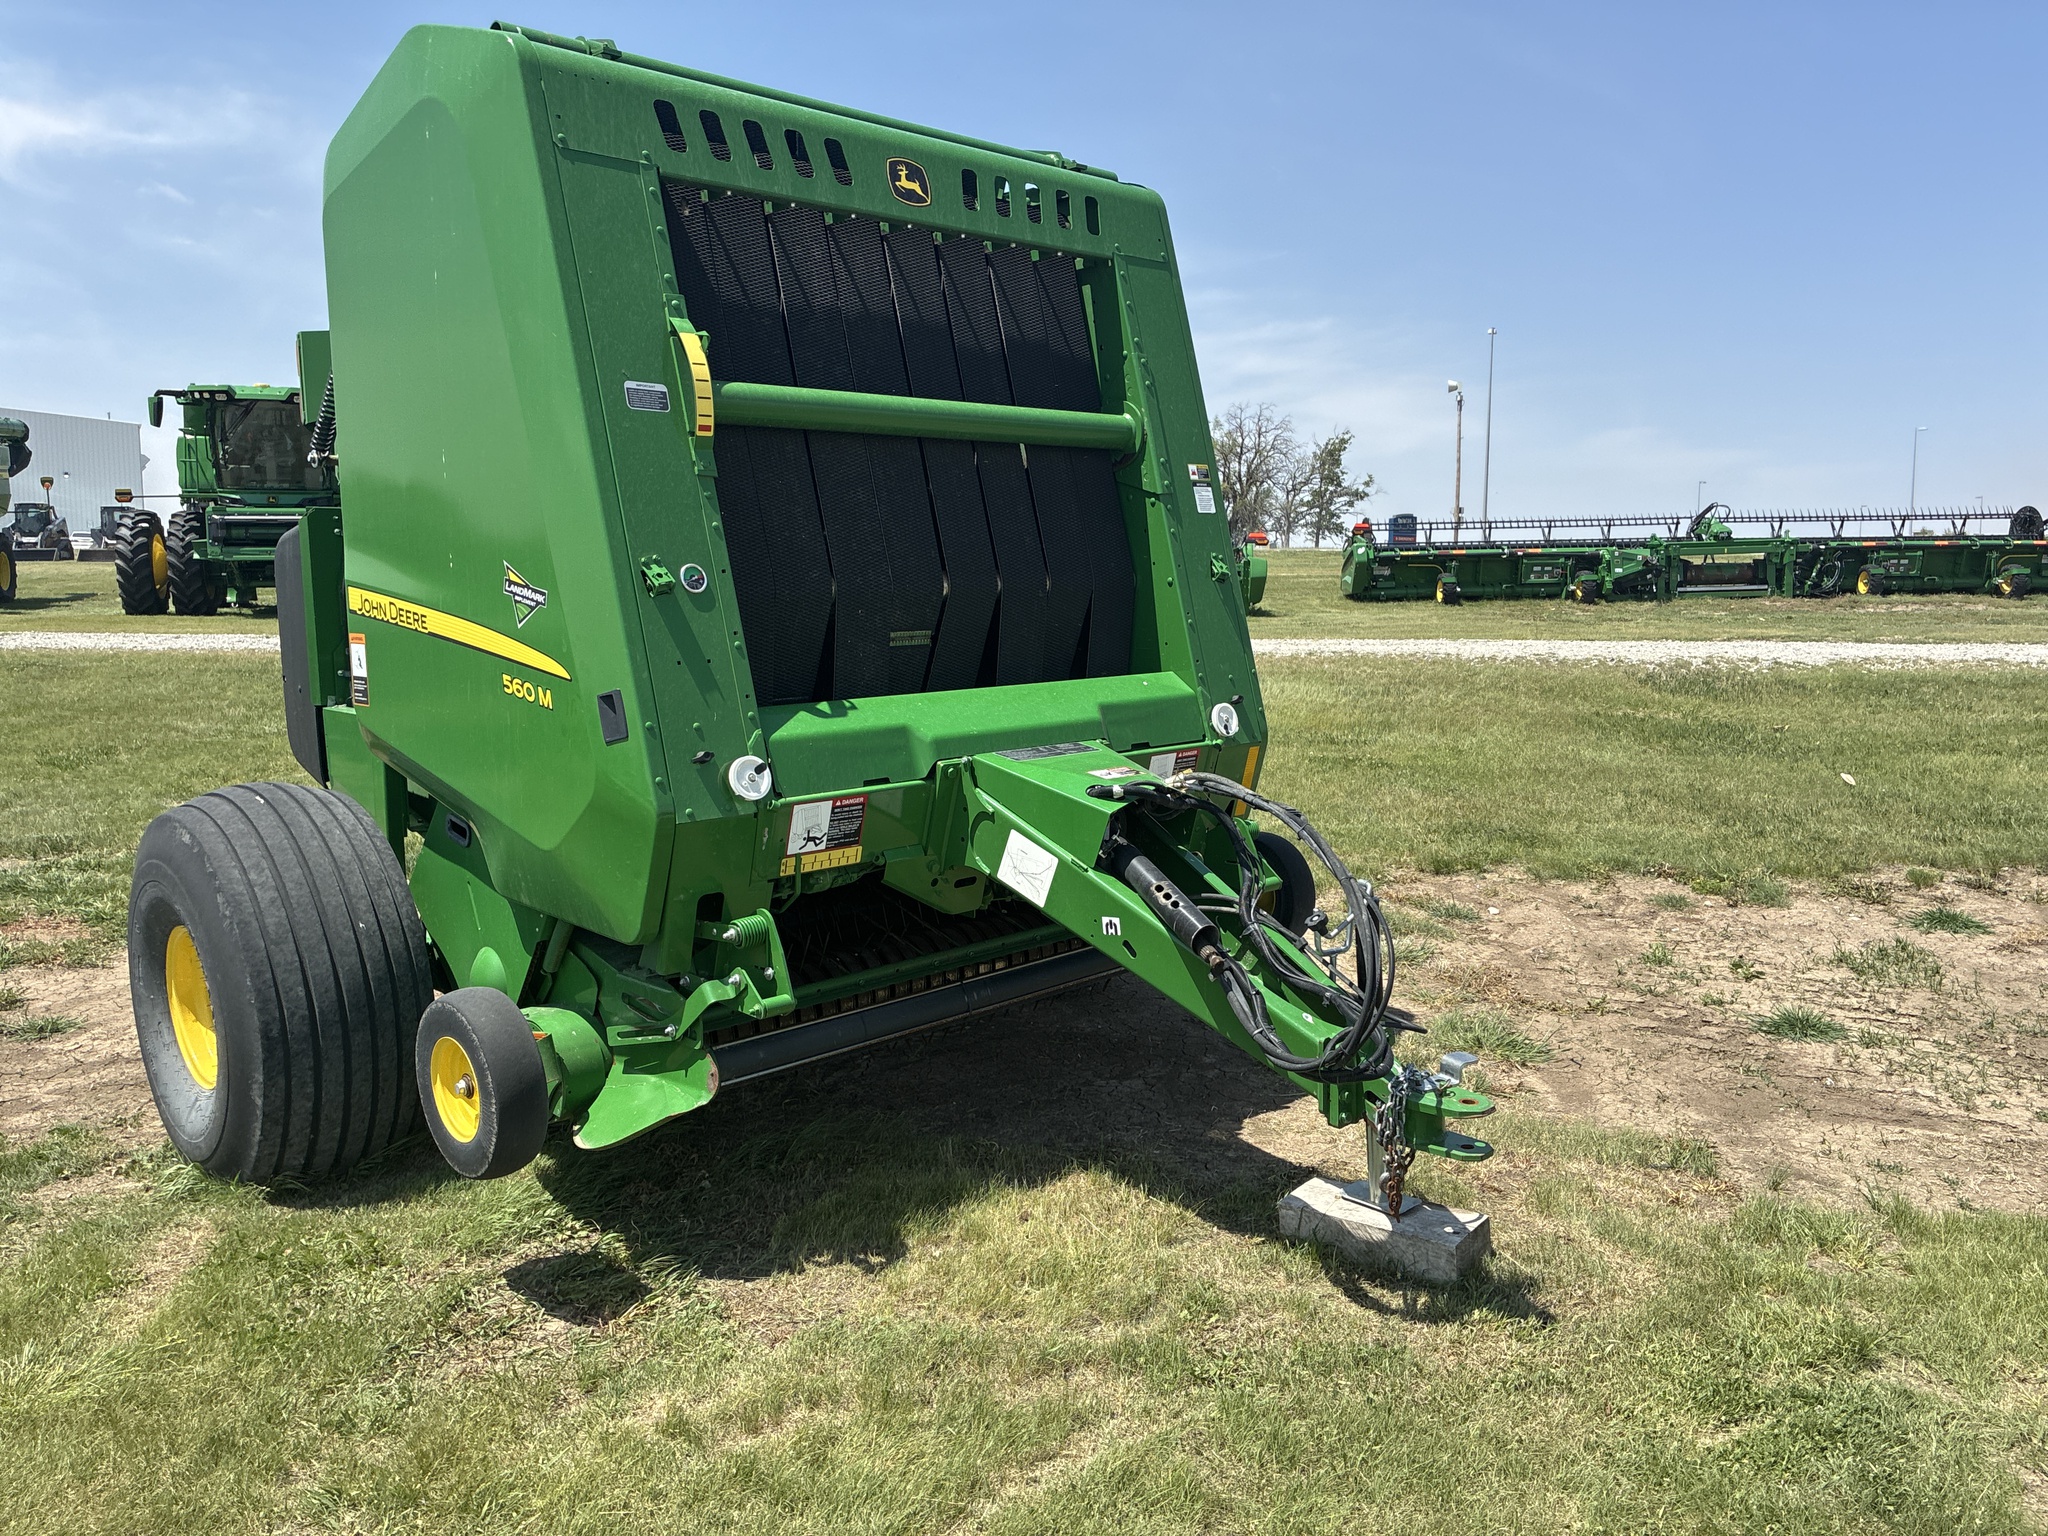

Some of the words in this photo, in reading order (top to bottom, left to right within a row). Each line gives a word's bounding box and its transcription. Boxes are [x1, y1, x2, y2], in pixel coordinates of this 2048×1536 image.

[505, 580, 546, 604] LANDMARK
[357, 593, 387, 619] JOHN
[389, 600, 428, 631] DEERE
[502, 672, 536, 703] 560
[537, 684, 554, 711] M
[841, 797, 864, 806] DANGER
